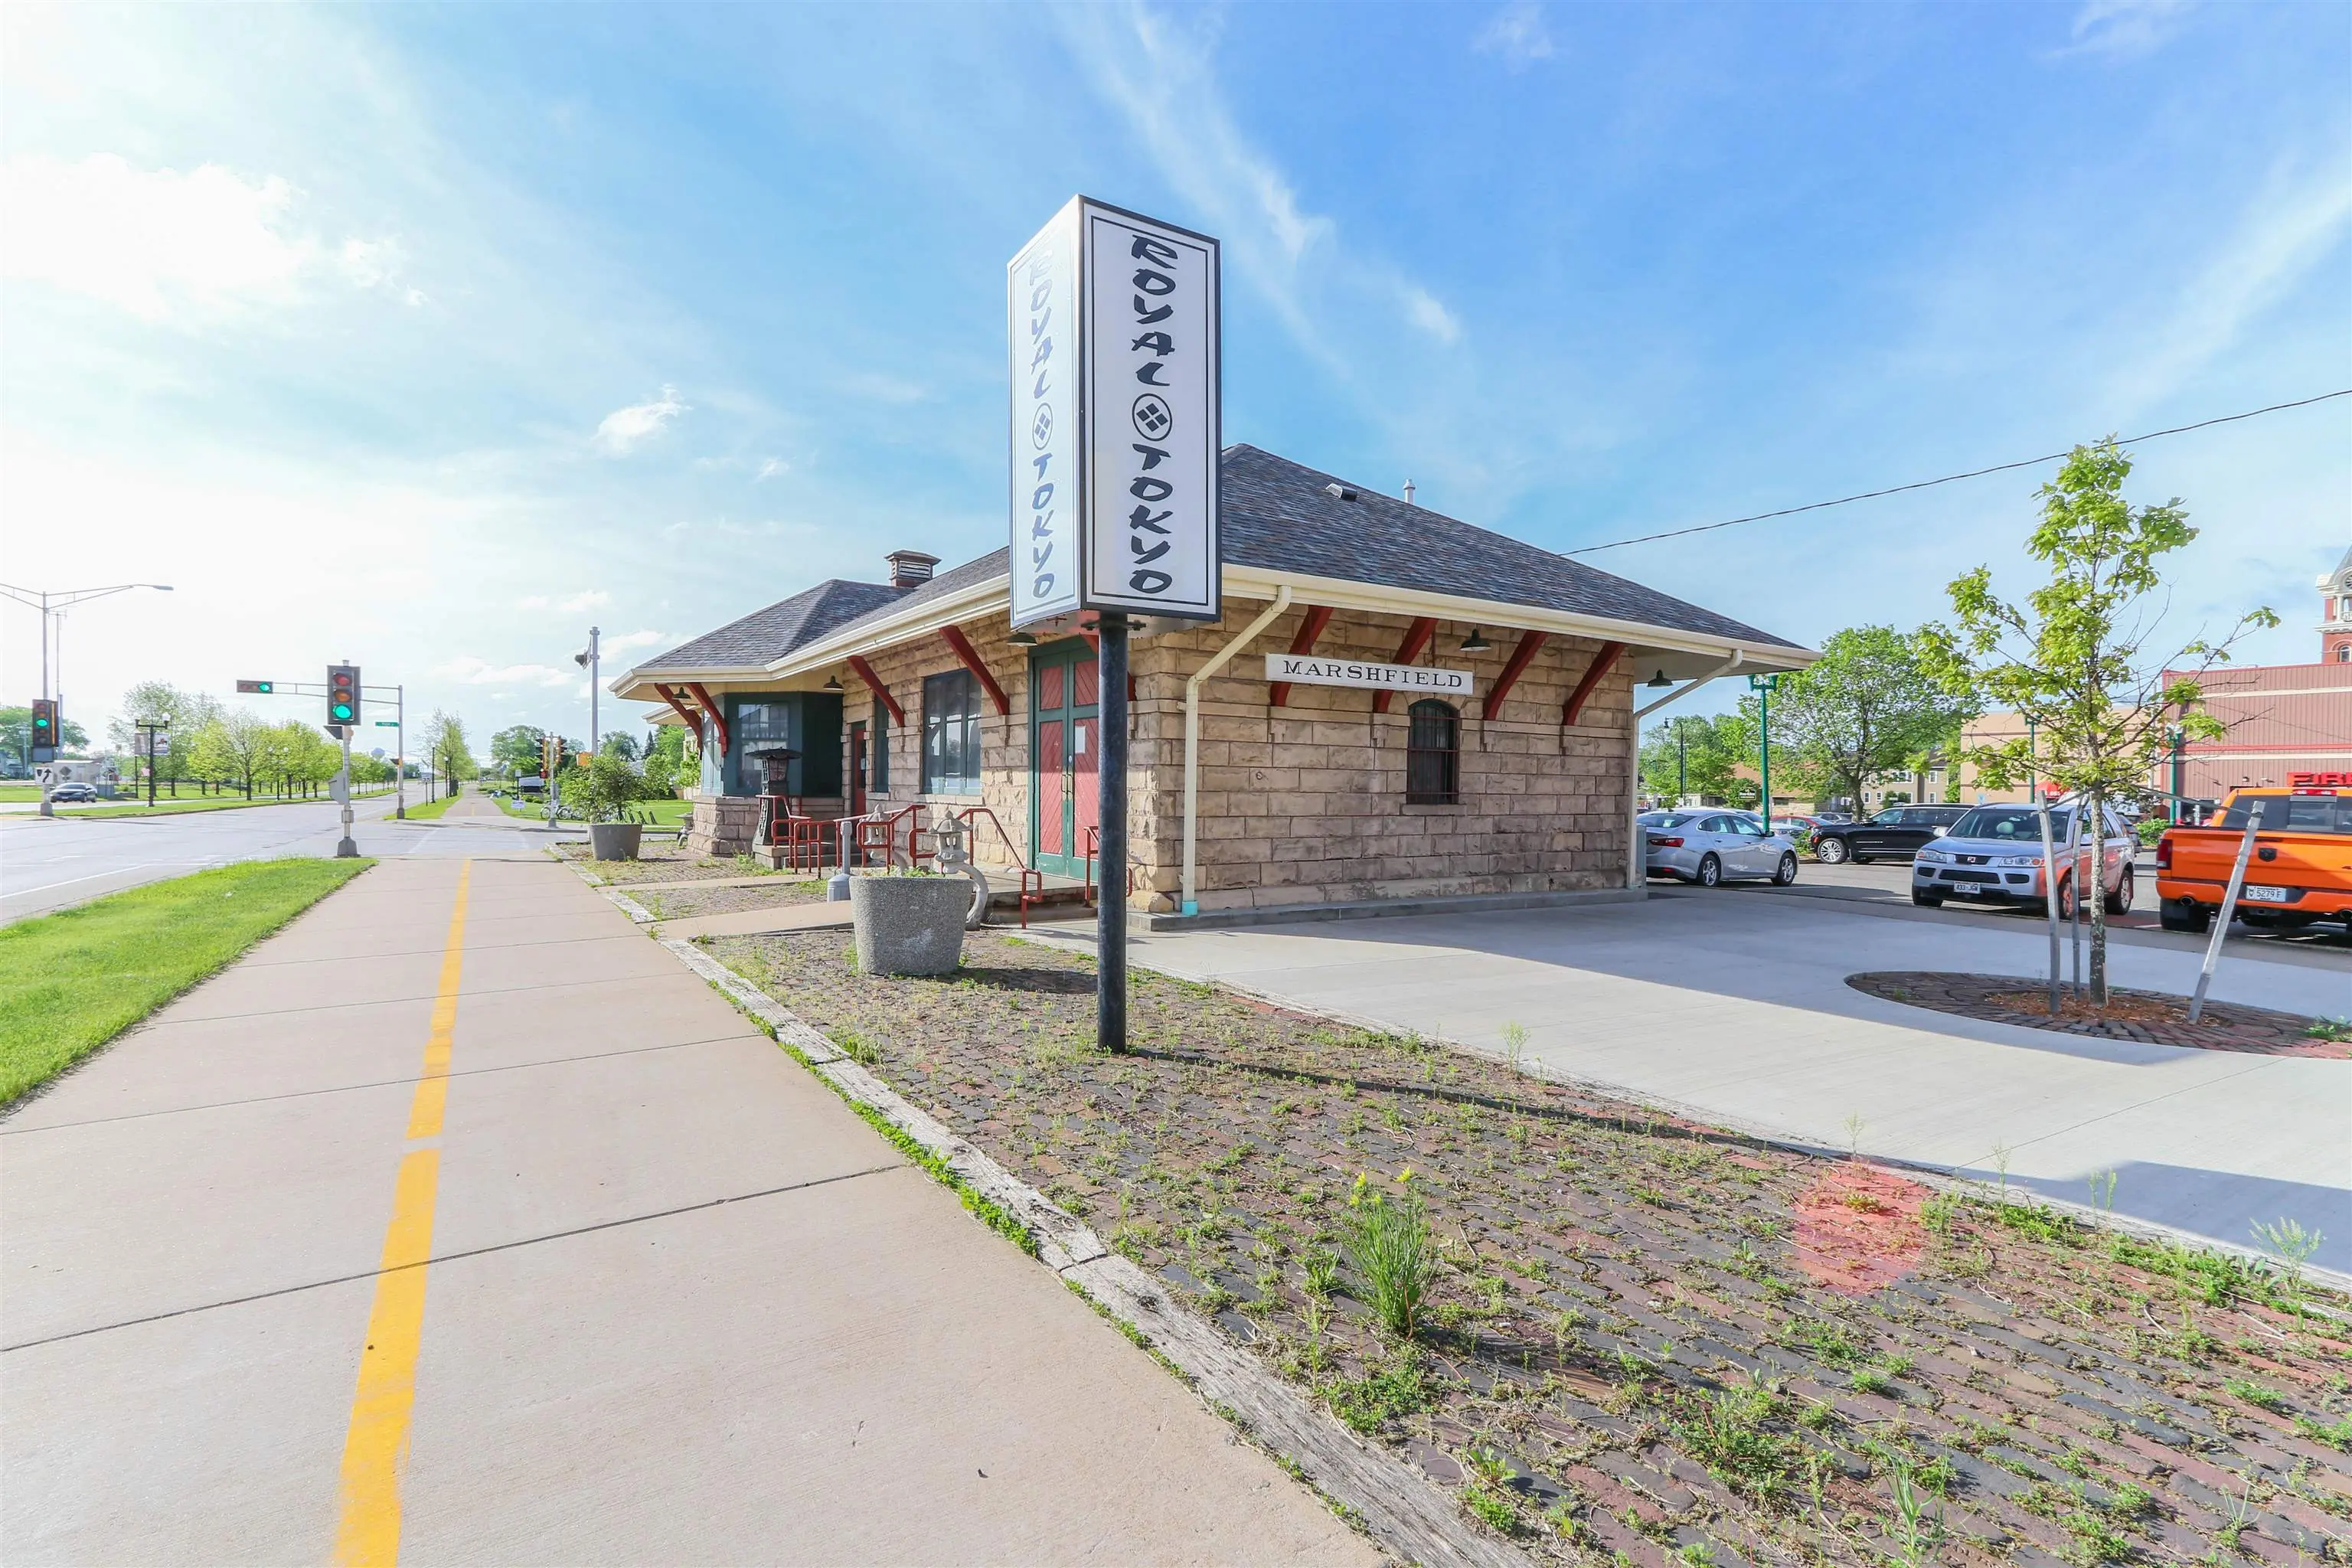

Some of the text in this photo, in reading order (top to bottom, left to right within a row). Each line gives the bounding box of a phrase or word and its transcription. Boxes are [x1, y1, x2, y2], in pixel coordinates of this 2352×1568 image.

[1129, 234, 1178, 594] ROYAL TOKYO
[1032, 452, 1054, 599] TOKYO
[1282, 659, 1463, 688] MARSHFIELD
